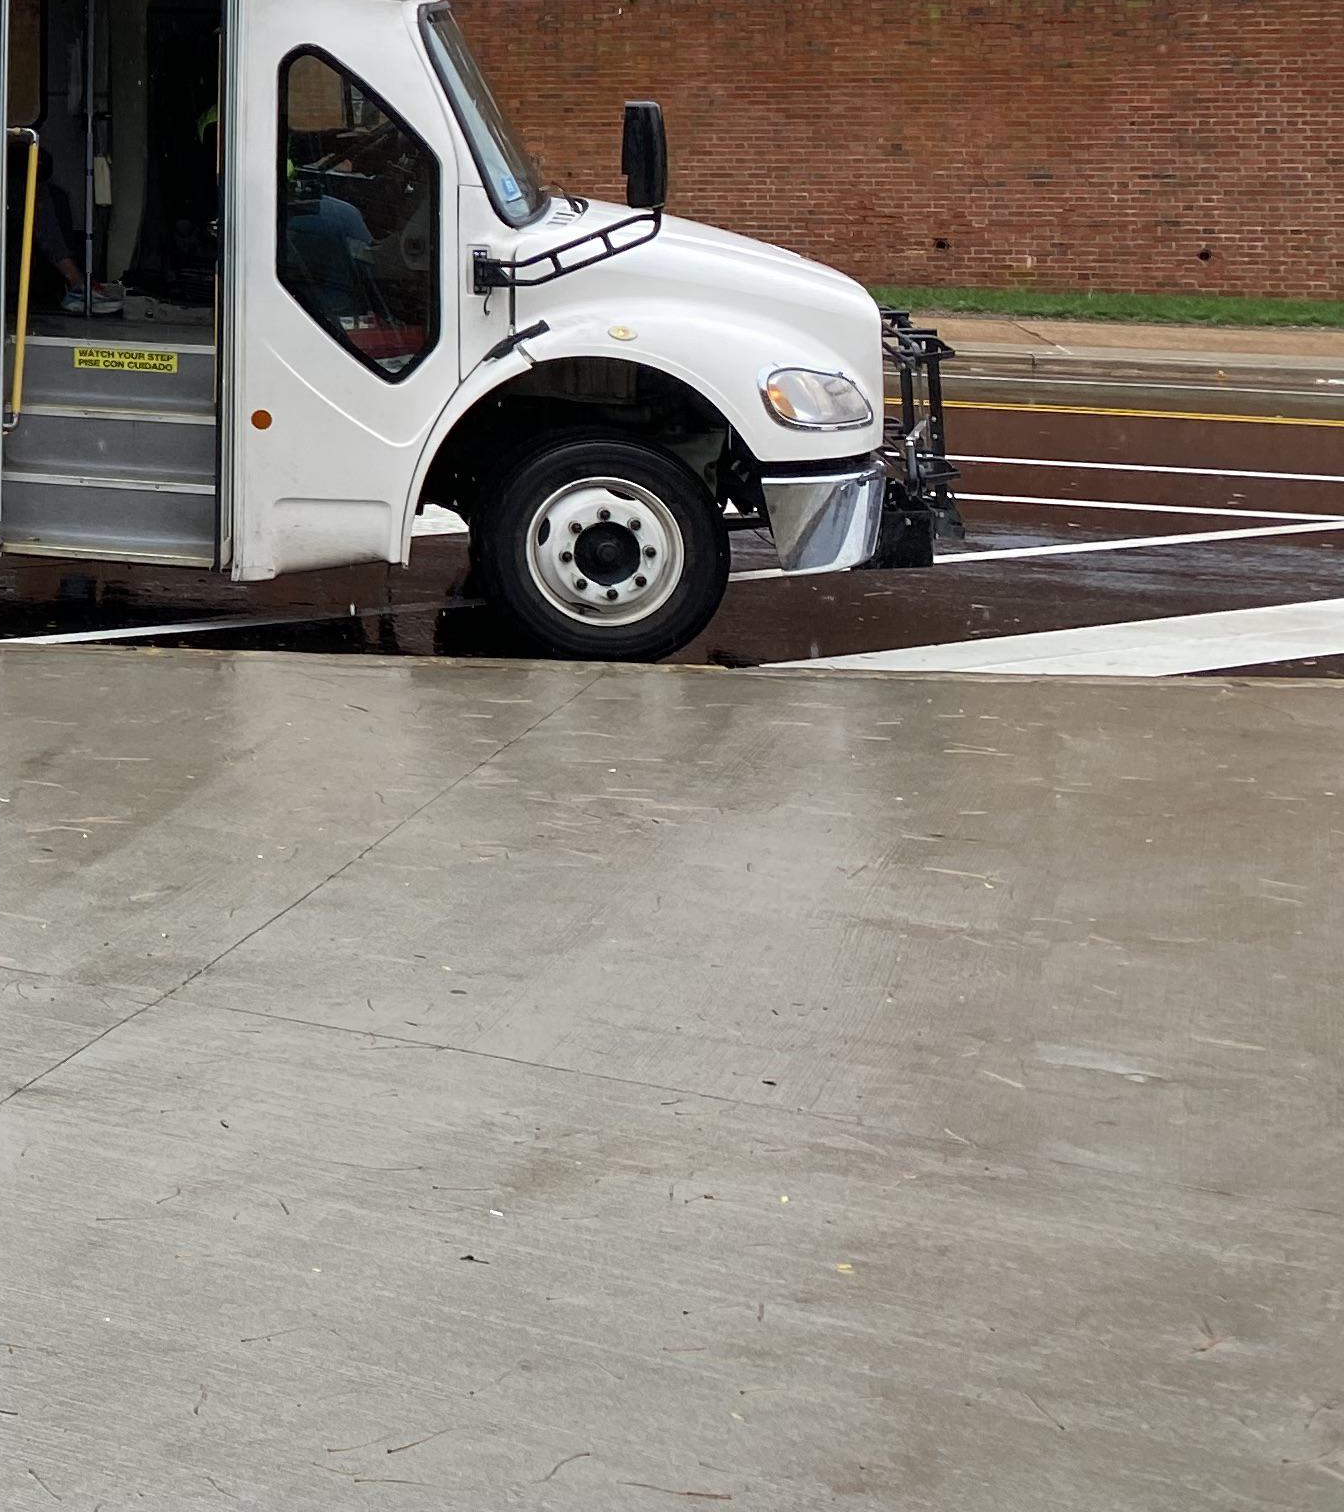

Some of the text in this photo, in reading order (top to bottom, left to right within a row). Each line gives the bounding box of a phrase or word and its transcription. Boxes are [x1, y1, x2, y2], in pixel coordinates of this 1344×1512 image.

[78, 349, 174, 362] WATCH YOUR STEP
[78, 358, 173, 371] PISE CON CUIDADO
